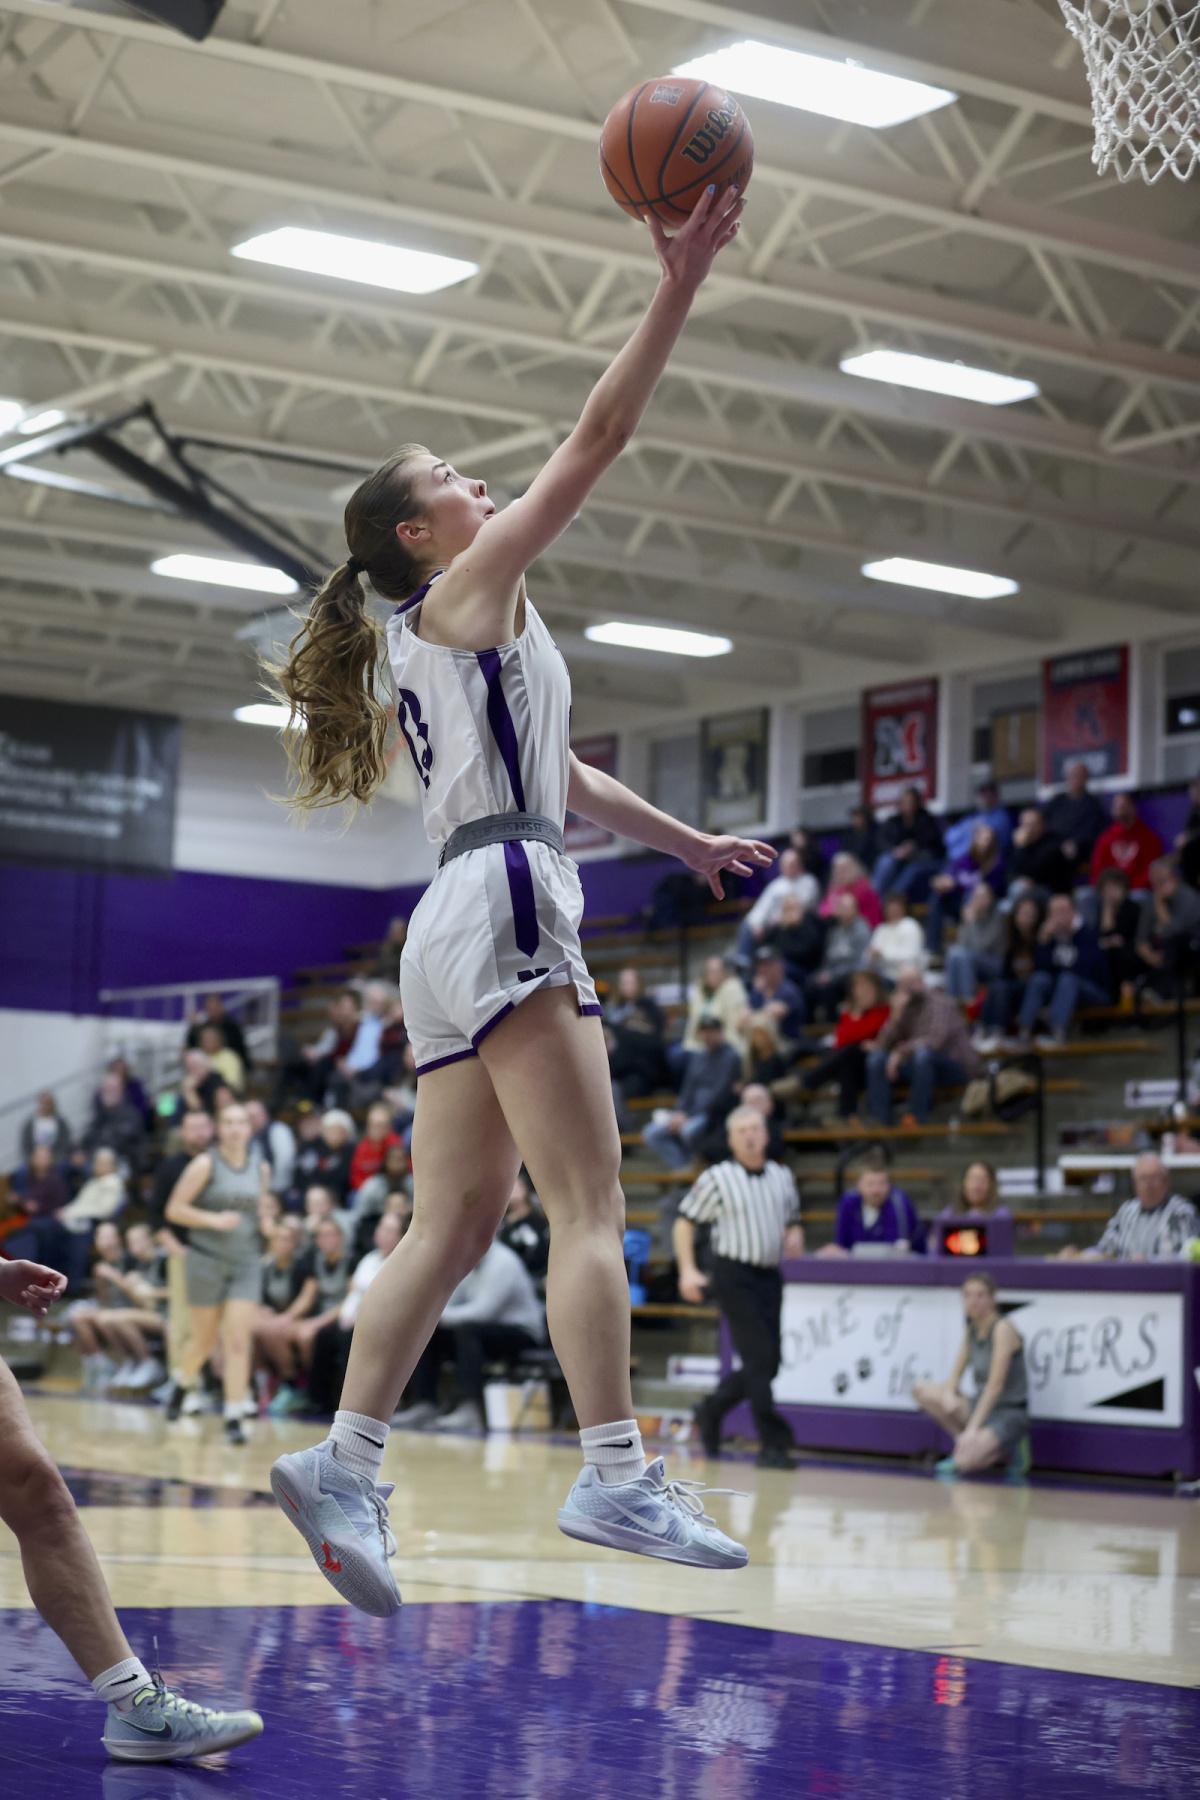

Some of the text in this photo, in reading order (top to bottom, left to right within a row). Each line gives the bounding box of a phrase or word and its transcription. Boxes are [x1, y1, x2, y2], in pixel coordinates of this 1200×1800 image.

[779, 1287, 913, 1371] OME of
[1027, 1311, 1159, 1391] GERS
